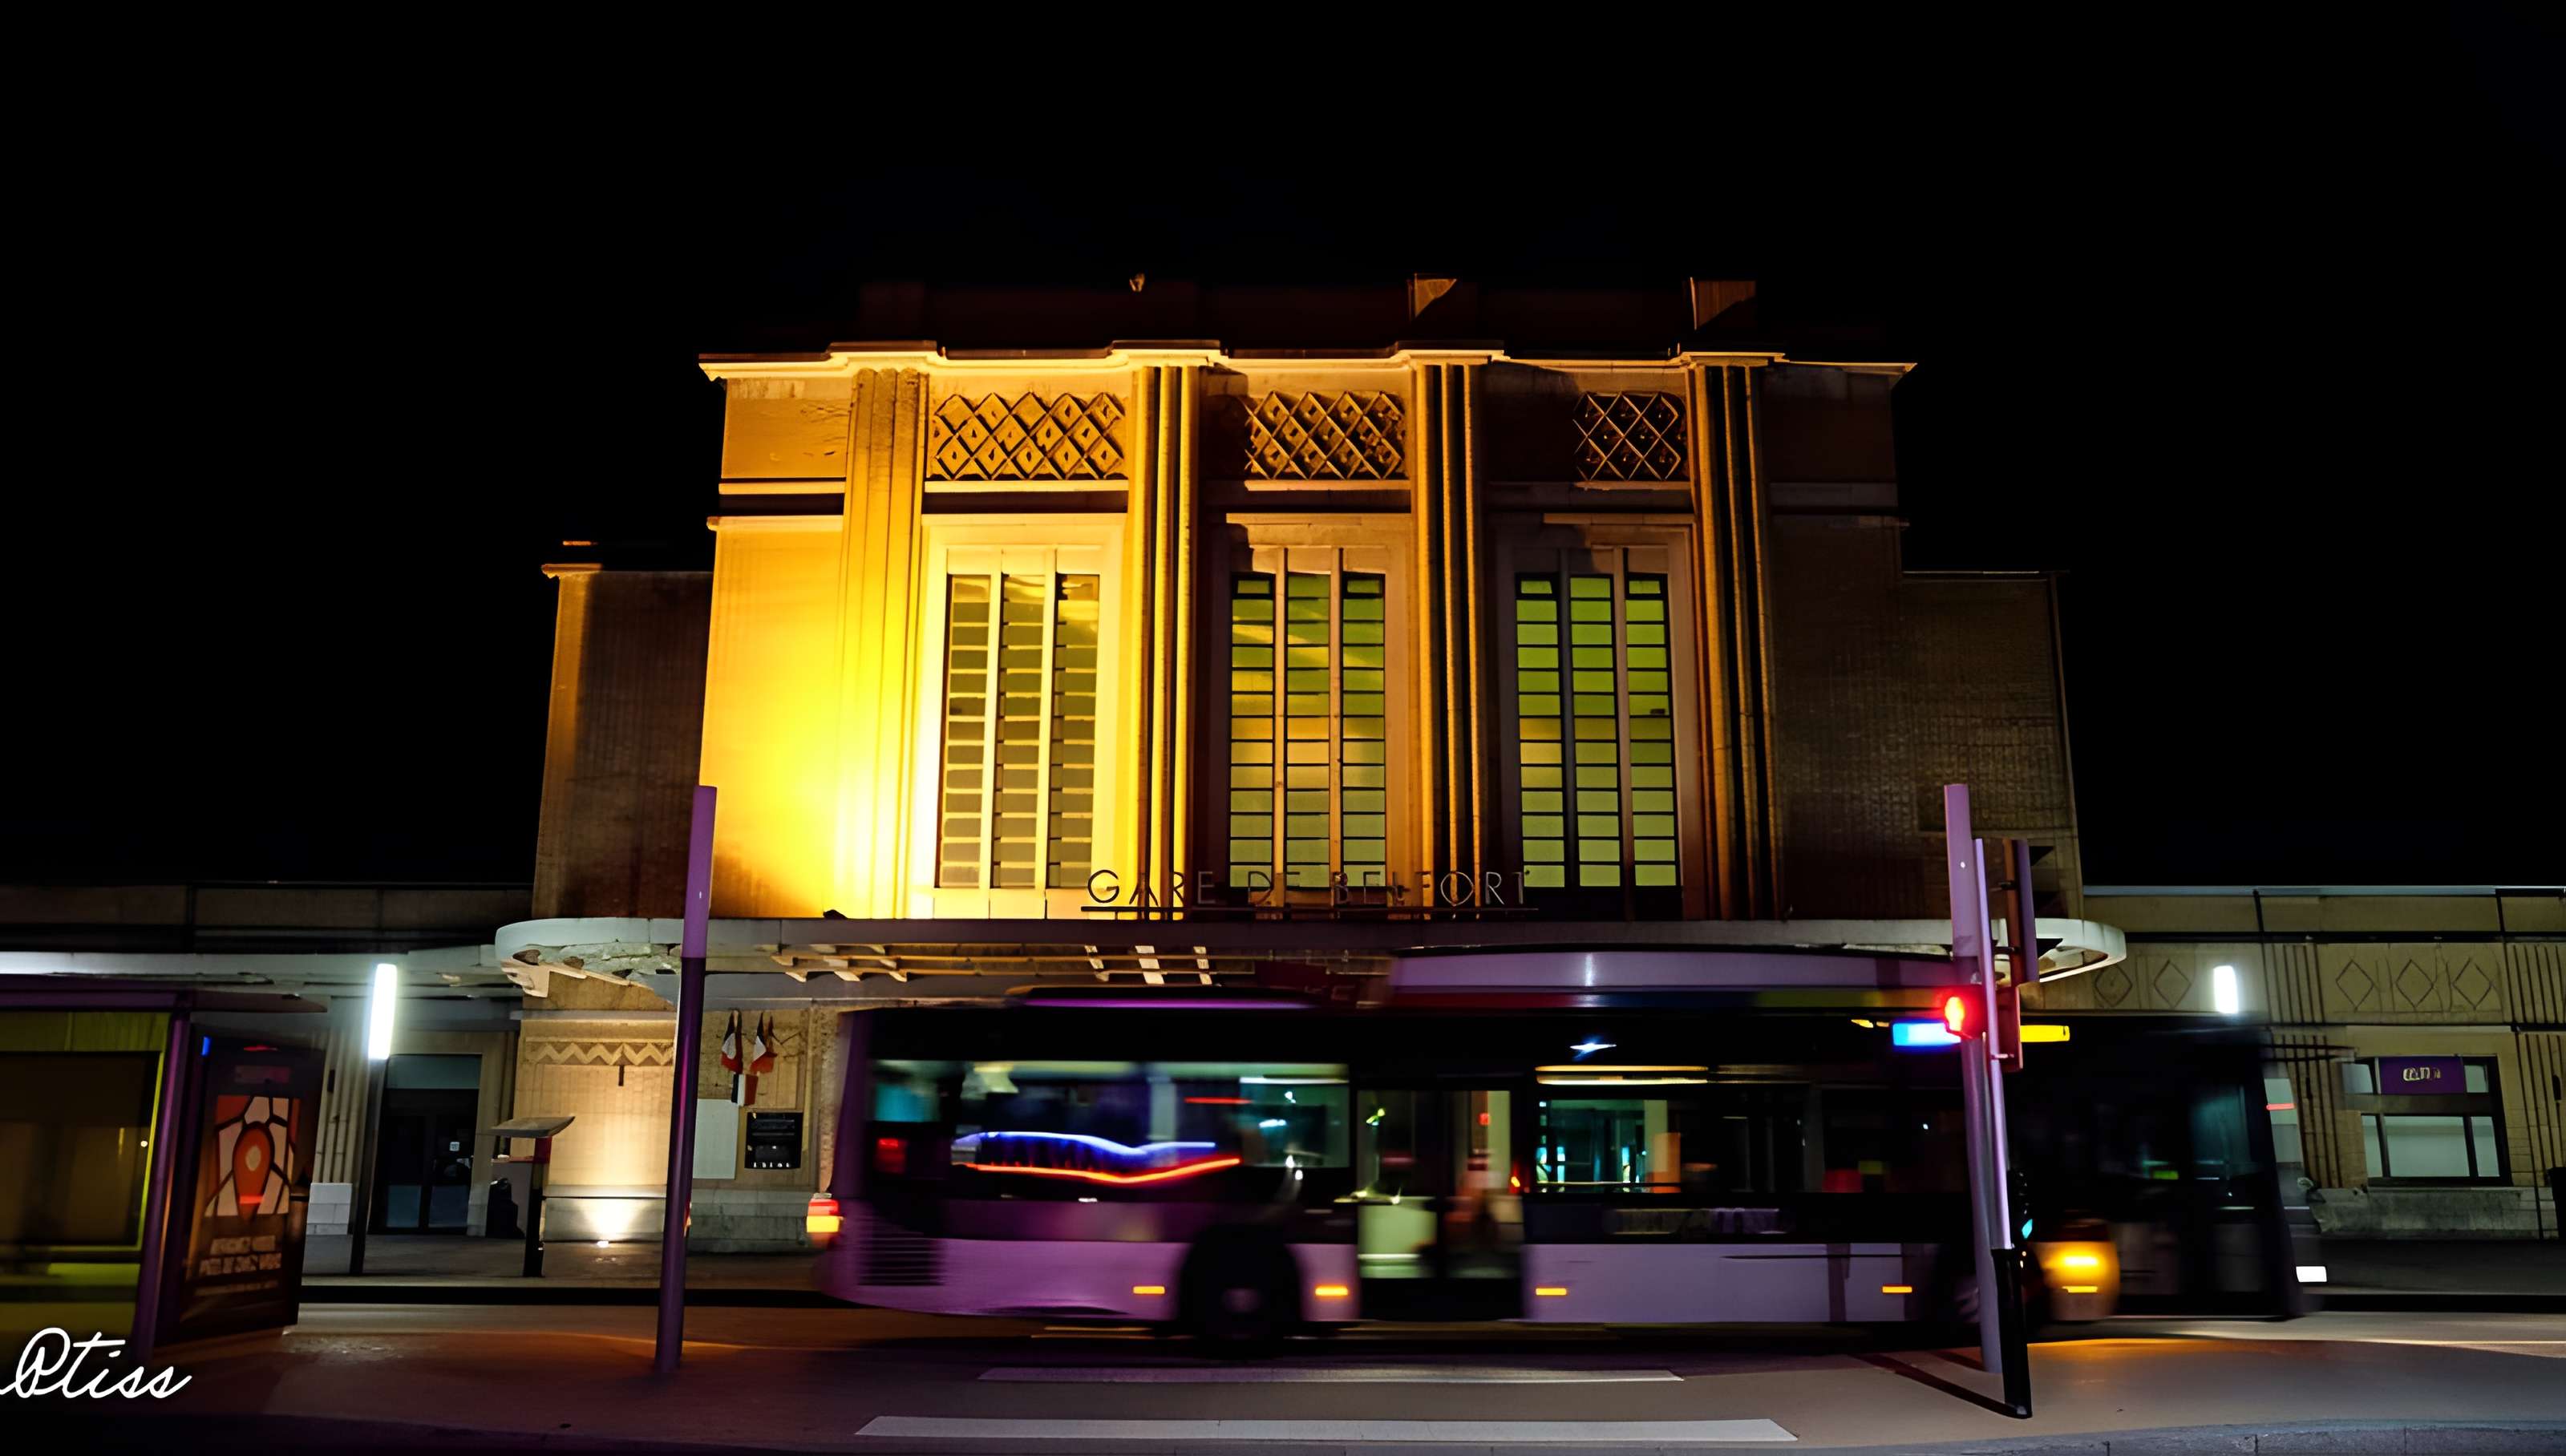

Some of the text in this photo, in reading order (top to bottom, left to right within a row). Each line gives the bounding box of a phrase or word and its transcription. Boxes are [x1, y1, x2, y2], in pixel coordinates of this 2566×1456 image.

[1087, 869, 1529, 908] GARE DE BELFORT
